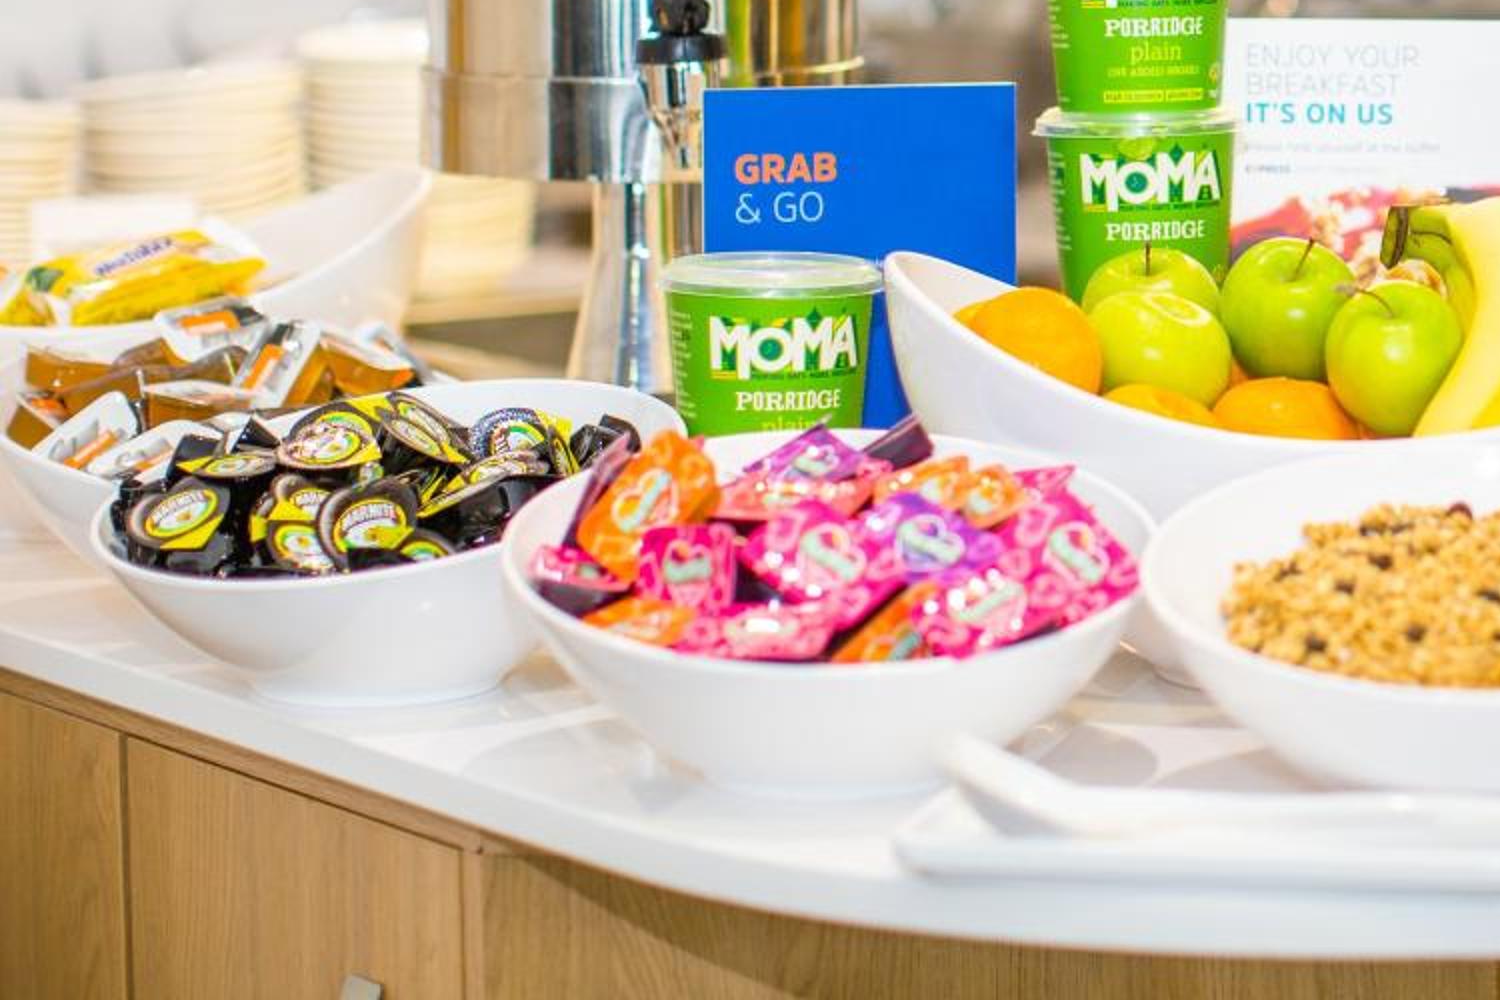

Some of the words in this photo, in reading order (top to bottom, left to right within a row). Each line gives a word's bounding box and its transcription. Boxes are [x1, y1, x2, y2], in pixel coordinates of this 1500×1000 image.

[1104, 16, 1204, 37] PORRIDGE
[1130, 41, 1182, 65] plain
[1247, 43, 1331, 69] ENJOY
[1344, 44, 1422, 69] YOUR
[1246, 72, 1401, 97] BREAKFAST
[1245, 102, 1296, 124] IT'S
[1306, 102, 1345, 125] ON
[1358, 102, 1393, 126] US
[736, 152, 837, 184] GRAB
[1079, 151, 1221, 212] MOMA
[735, 193, 761, 224] &
[774, 191, 823, 223] GO
[1106, 219, 1205, 241] PORRIDGE
[709, 314, 858, 380] MOMA
[735, 388, 842, 411] PORRIDGE
